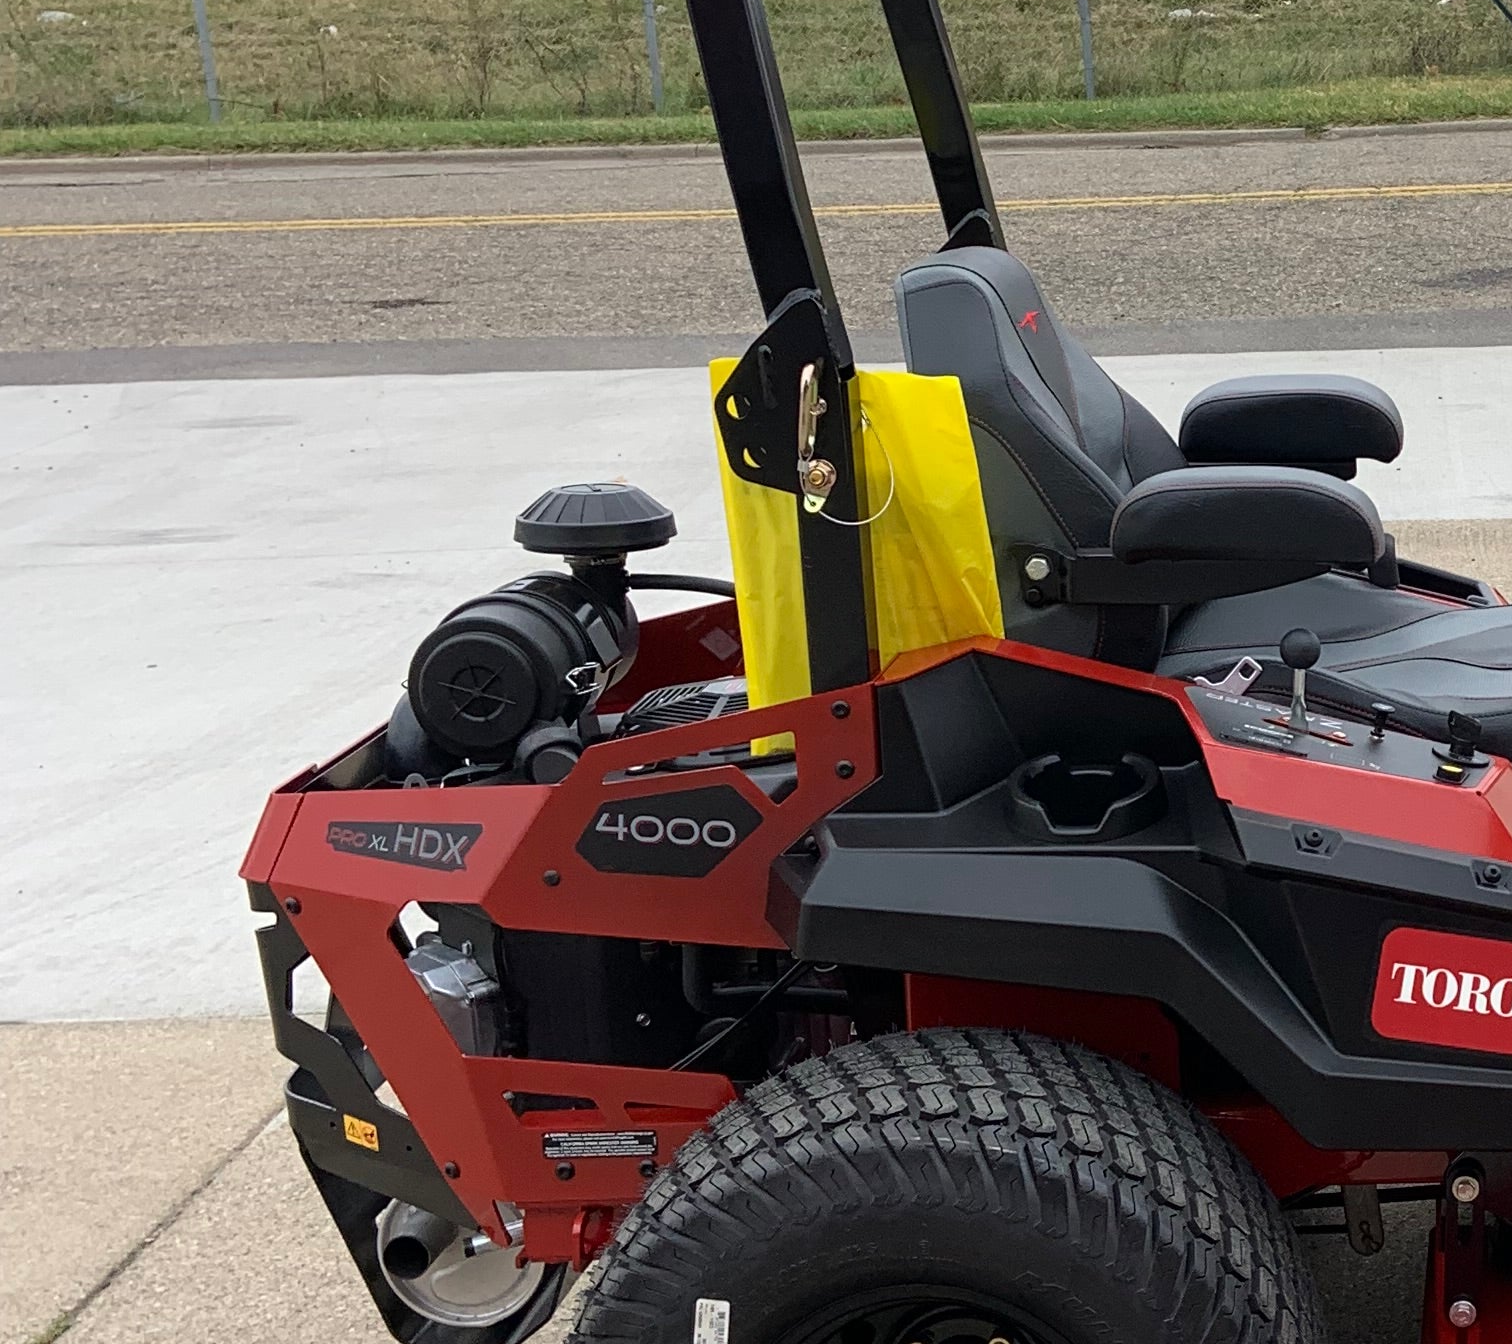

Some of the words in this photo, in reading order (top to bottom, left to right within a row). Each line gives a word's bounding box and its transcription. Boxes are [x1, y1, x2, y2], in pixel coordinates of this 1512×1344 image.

[326, 826, 366, 848] PRO
[368, 833, 390, 853] XL
[393, 823, 470, 867] HDX
[594, 812, 738, 848] 4000
